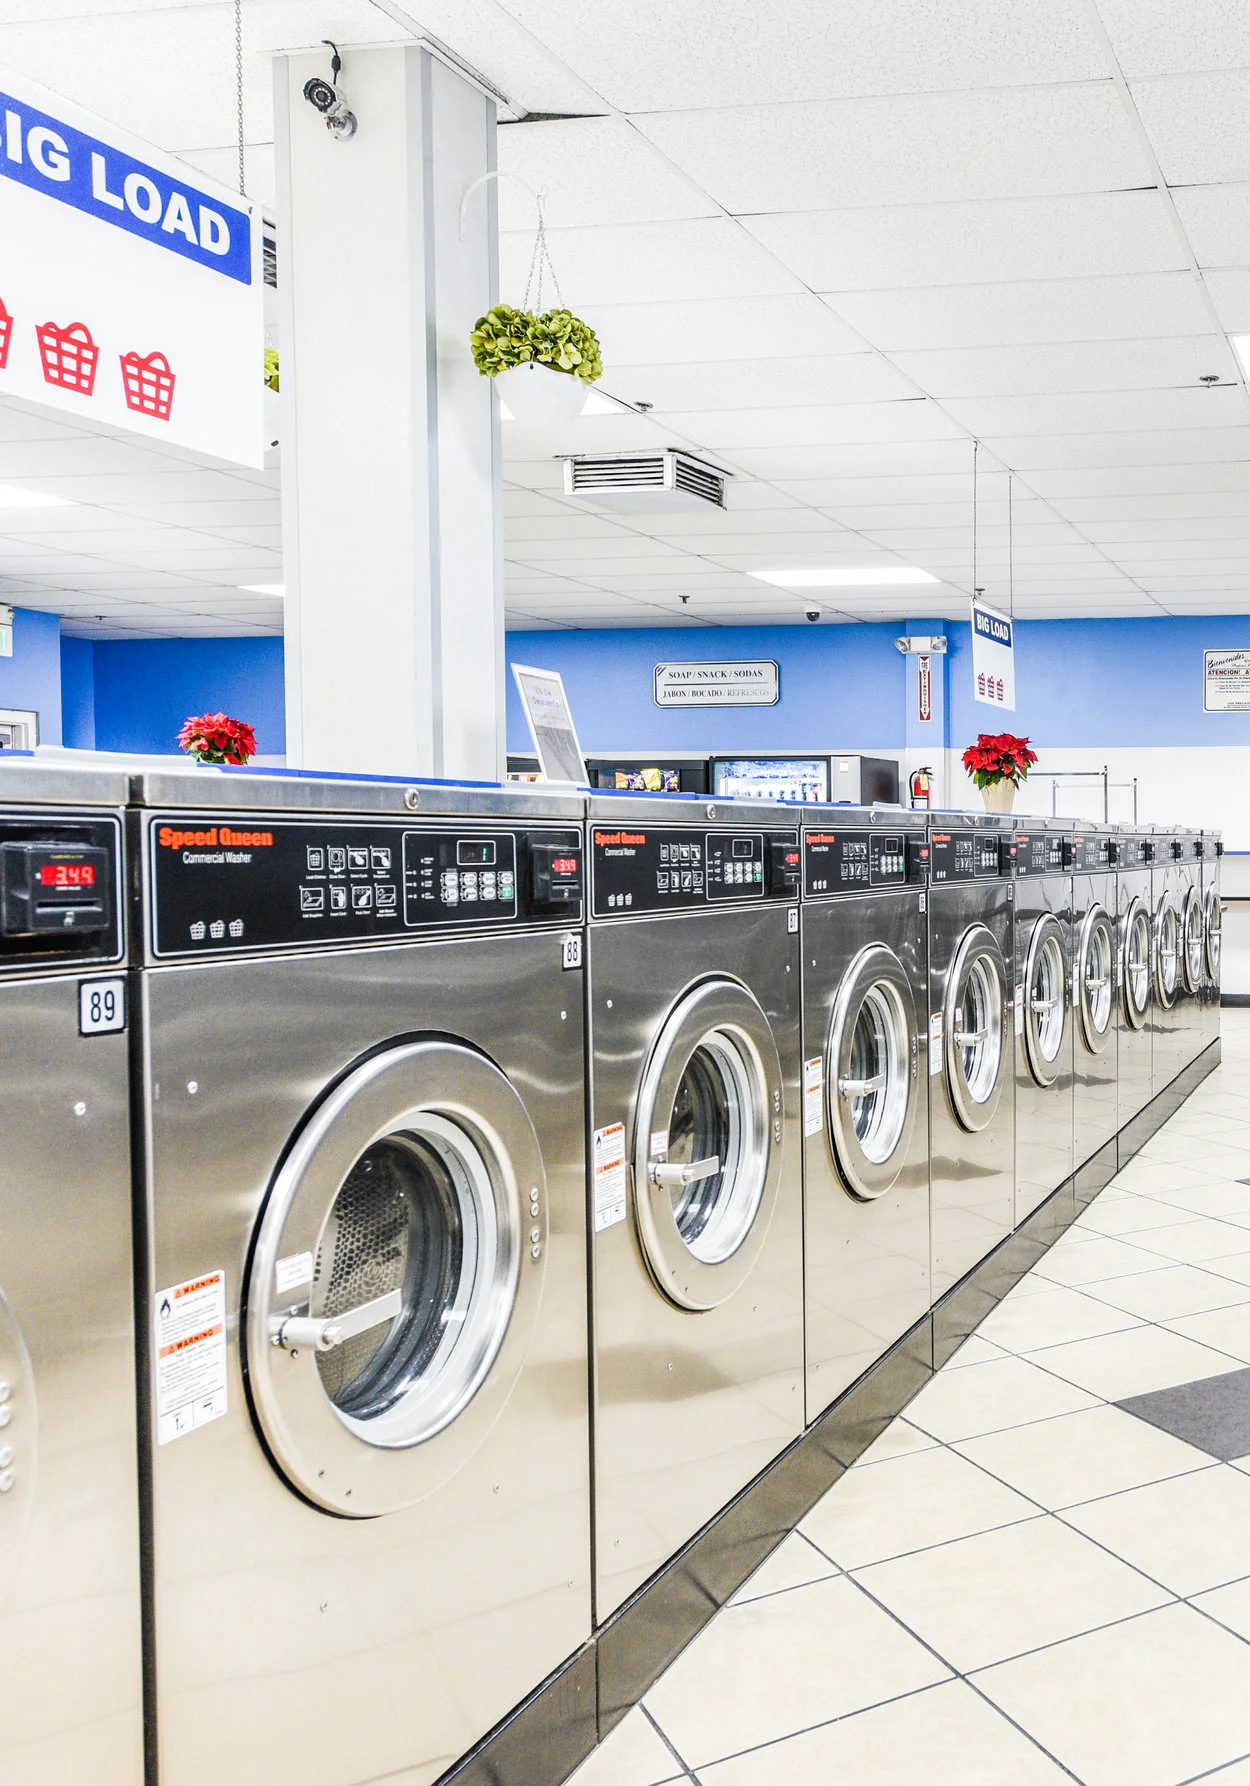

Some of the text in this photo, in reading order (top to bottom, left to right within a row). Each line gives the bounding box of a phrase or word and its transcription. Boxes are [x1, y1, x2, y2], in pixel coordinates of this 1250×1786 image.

[0, 109, 231, 256] IG LOAD
[976, 613, 1009, 641] BIG LOAD
[668, 671, 692, 679] SOAP
[697, 670, 727, 678] SNACK
[733, 669, 763, 678] SODAS
[663, 690, 686, 698] JABON
[691, 689, 722, 698] BOCADO
[159, 827, 273, 850] Speed Queen
[595, 832, 646, 846] Speed Queen
[182, 851, 252, 864] Commercial Washer
[567, 941, 578, 962] 88
[90, 990, 115, 1023] 89
[183, 1274, 220, 1295] WARNING
[176, 1329, 214, 1350] WARNING
